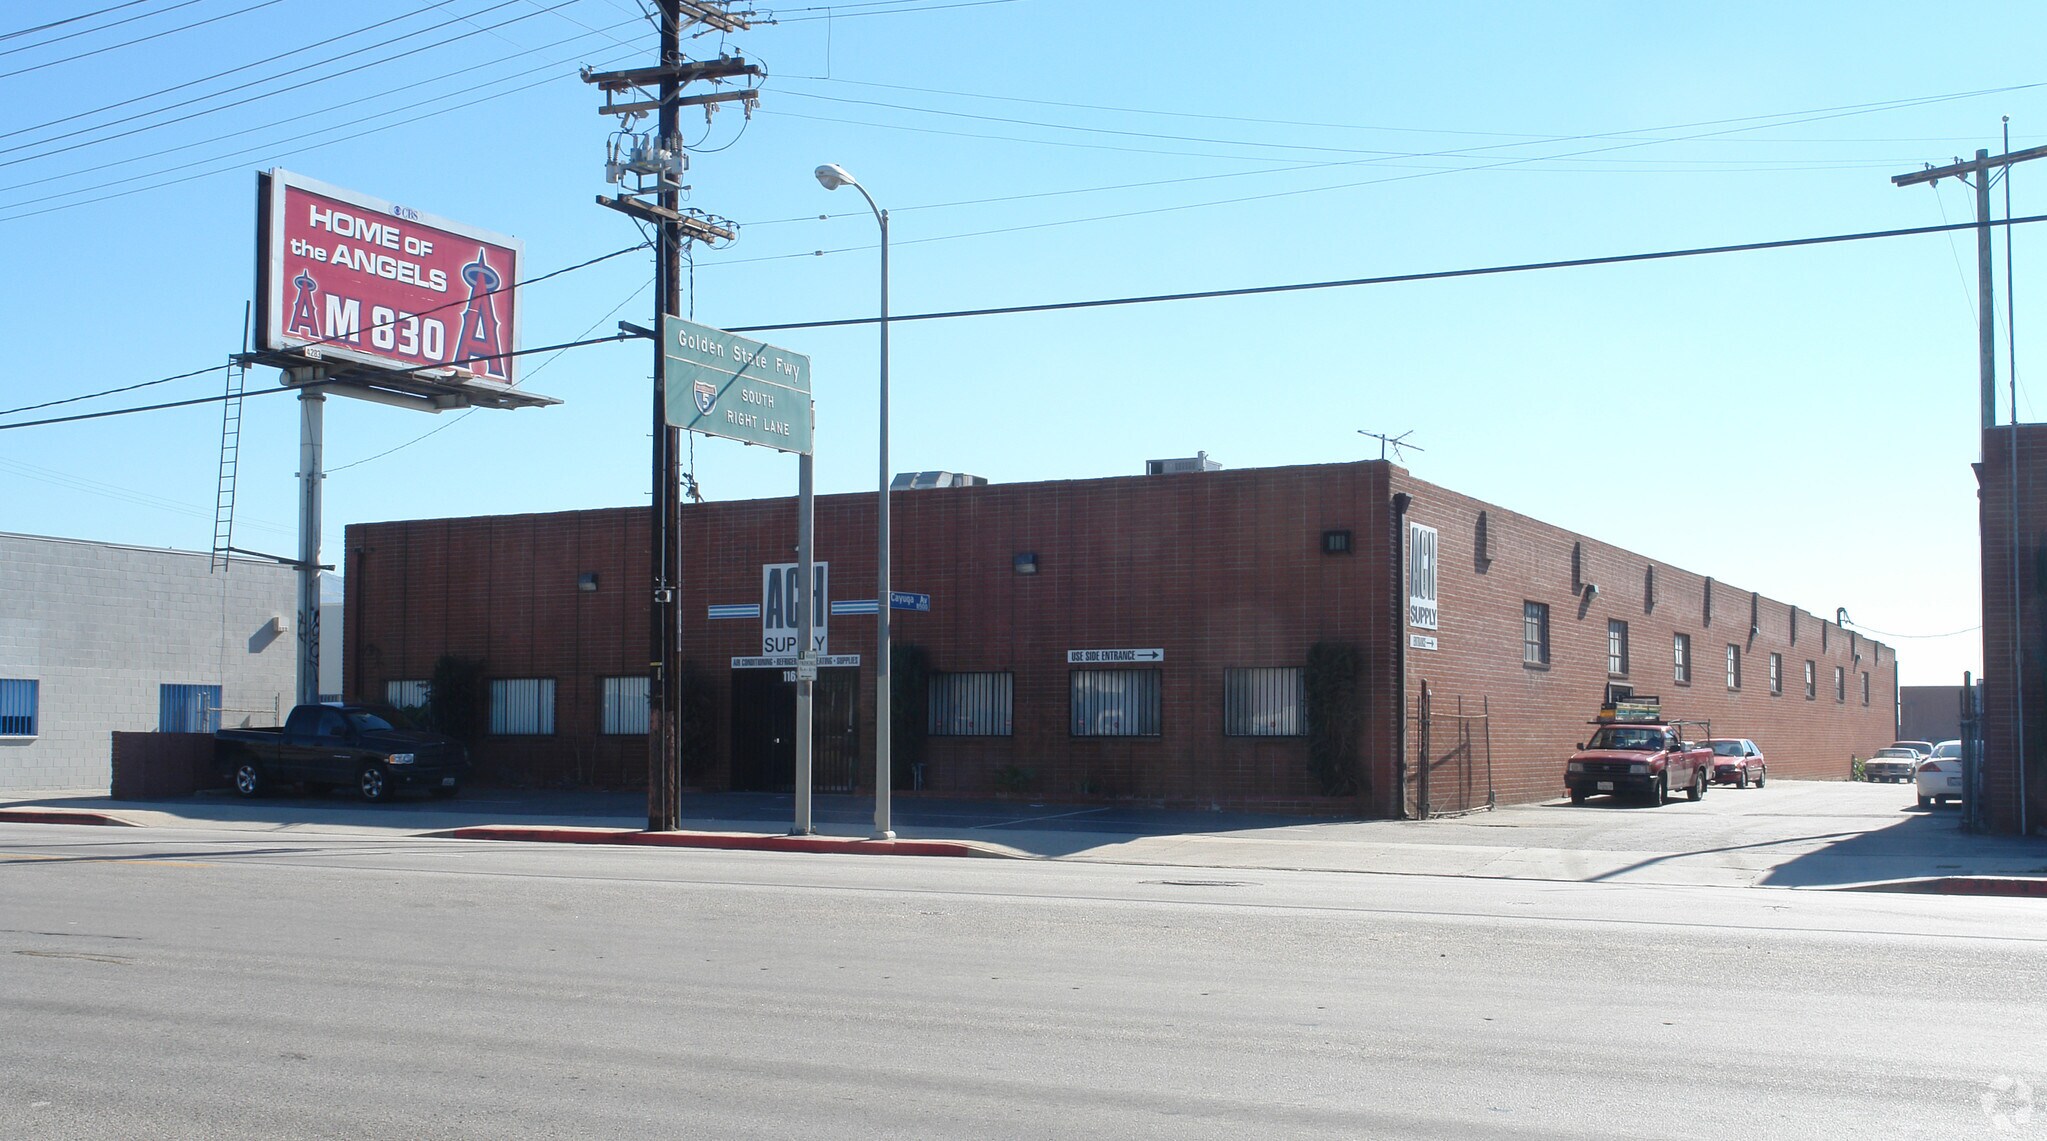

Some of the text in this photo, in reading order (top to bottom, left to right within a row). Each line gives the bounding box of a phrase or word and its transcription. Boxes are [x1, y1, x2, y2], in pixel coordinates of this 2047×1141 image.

[402, 207, 418, 221] CBS
[309, 205, 433, 256] HOME OF
[290, 238, 447, 292] the ANGELS
[371, 305, 445, 363] 830
[678, 330, 800, 383] Golden State Fwy
[702, 392, 710, 409] 5
[742, 388, 774, 409] SOUTH
[727, 410, 790, 436] RIGHT LANE
[1410, 527, 1436, 601] ACH
[891, 592, 914, 605] Cayuga
[1410, 605, 1437, 626] SUPPLY
[764, 637, 825, 653] SUPY
[1071, 650, 1136, 661] USE SIDE ENTRANCE
[733, 658, 741, 667] AIR
[742, 657, 773, 666] CONDITIONING
[816, 656, 832, 665] EATING
[836, 656, 858, 665] SUPPLIES
